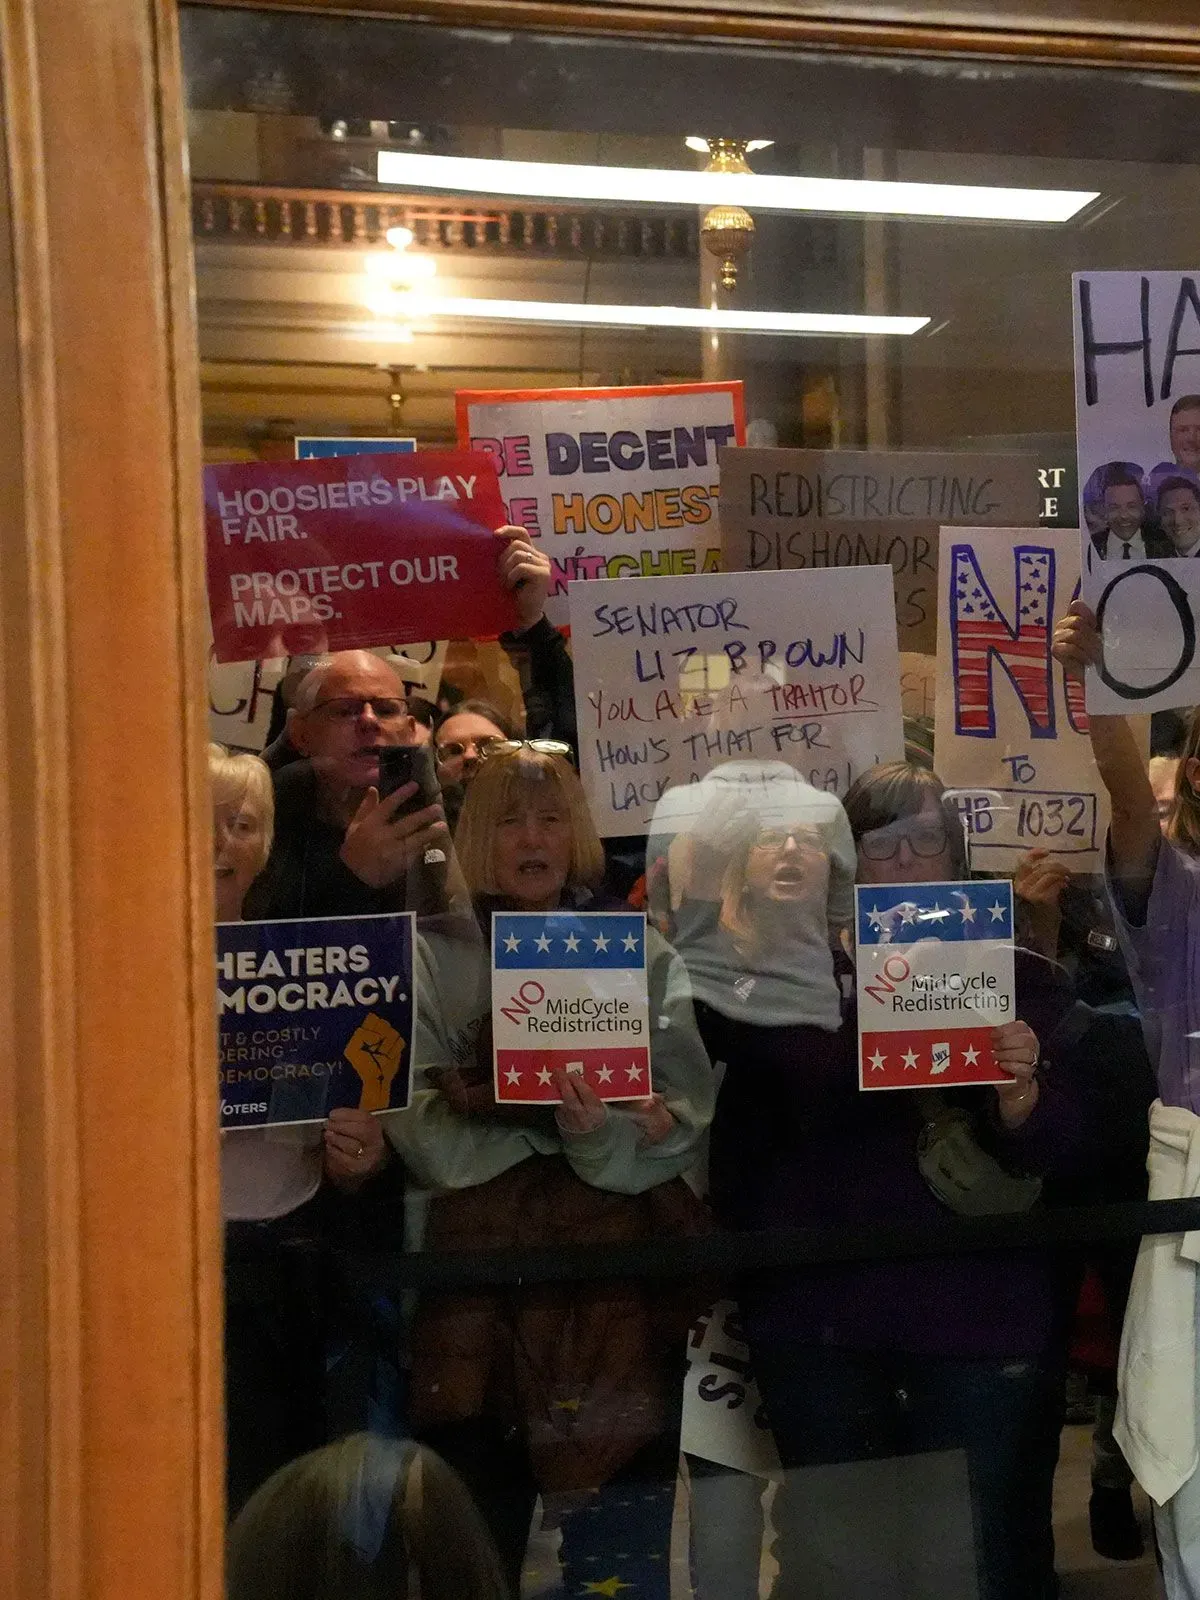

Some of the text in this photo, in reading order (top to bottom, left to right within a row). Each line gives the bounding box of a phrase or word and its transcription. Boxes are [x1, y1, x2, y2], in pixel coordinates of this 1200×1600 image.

[470, 424, 735, 477] BE DECENT
[216, 475, 477, 518] HOOSIERS PLAY
[749, 472, 1002, 517] REDISTRICTING
[221, 514, 309, 546] FAIR.
[501, 498, 541, 538] E
[230, 554, 460, 600] PROTECT OUR
[234, 594, 343, 629] MAPS.
[592, 597, 750, 638] SENATOR
[635, 627, 865, 683] LIZ BROWN
[950, 543, 1090, 740] N
[763, 673, 880, 713] TRAITOR
[682, 725, 763, 762] THAT
[770, 722, 832, 752] FOR
[1017, 797, 1086, 837] 1032
[864, 956, 997, 1006] NO MidCycle
[500, 980, 629, 1026] NO MidCycle
[892, 992, 1010, 1013] Redistricting
[252, 1026, 321, 1045] COSTLY
[528, 1016, 642, 1035] Redistricting
